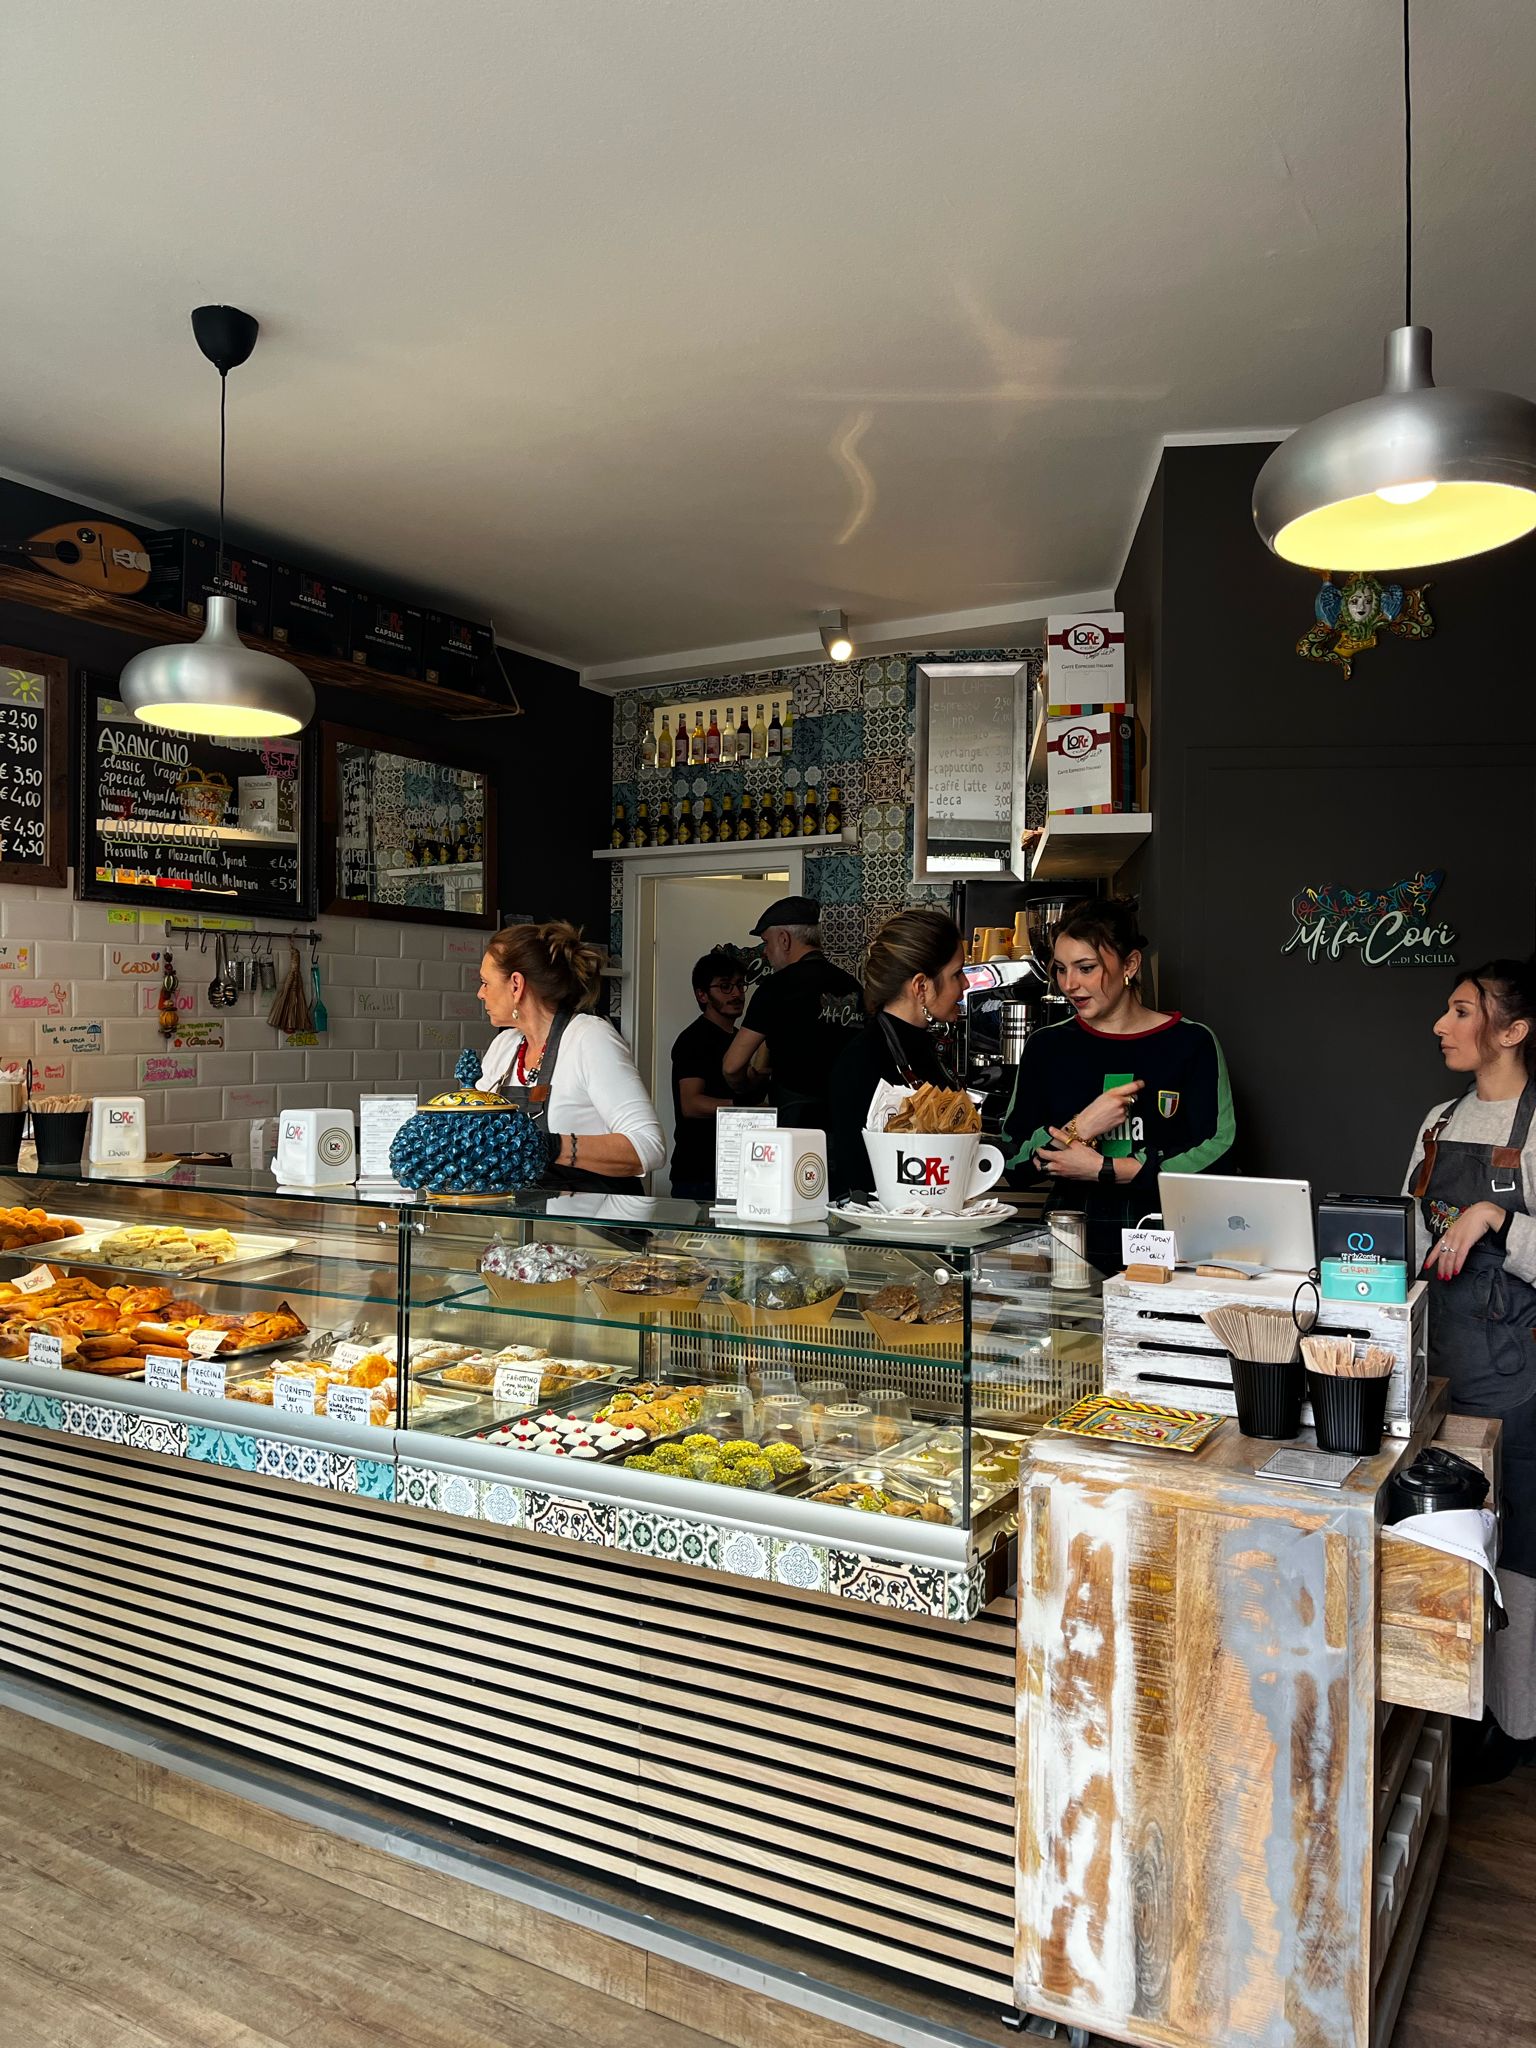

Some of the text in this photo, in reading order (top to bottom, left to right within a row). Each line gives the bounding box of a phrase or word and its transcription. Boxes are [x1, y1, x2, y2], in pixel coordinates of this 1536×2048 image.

[298, 594, 327, 608] CAPSULE
[374, 626, 404, 640] CAPSULE
[448, 639, 472, 651] CAPSULE
[7, 732, 38, 754] 3,50
[97, 727, 188, 766] ARANCINO
[101, 755, 143, 774] classic
[13, 766, 43, 787] 3,50
[101, 771, 147, 787] special
[963, 779, 988, 792] latte
[10, 786, 41, 808] 4,00
[0, 816, 45, 838] € 4,50
[101, 816, 221, 849] CARTOCCIATA
[13, 838, 44, 858] 4,50
[104, 841, 149, 860] Prosciutto
[154, 848, 162, 860] &
[269, 858, 279, 870] €
[113, 951, 121, 965] U
[1414, 952, 1456, 964] SICILIA
[1150, 1234, 1171, 1244] TODAY
[1129, 1243, 1151, 1254] CASH
[149, 1363, 180, 1379] TRECCINA
[191, 1367, 222, 1380] TRECCINA
[279, 1383, 312, 1399] CORNETTO
[332, 1393, 365, 1405] CORNETTO
